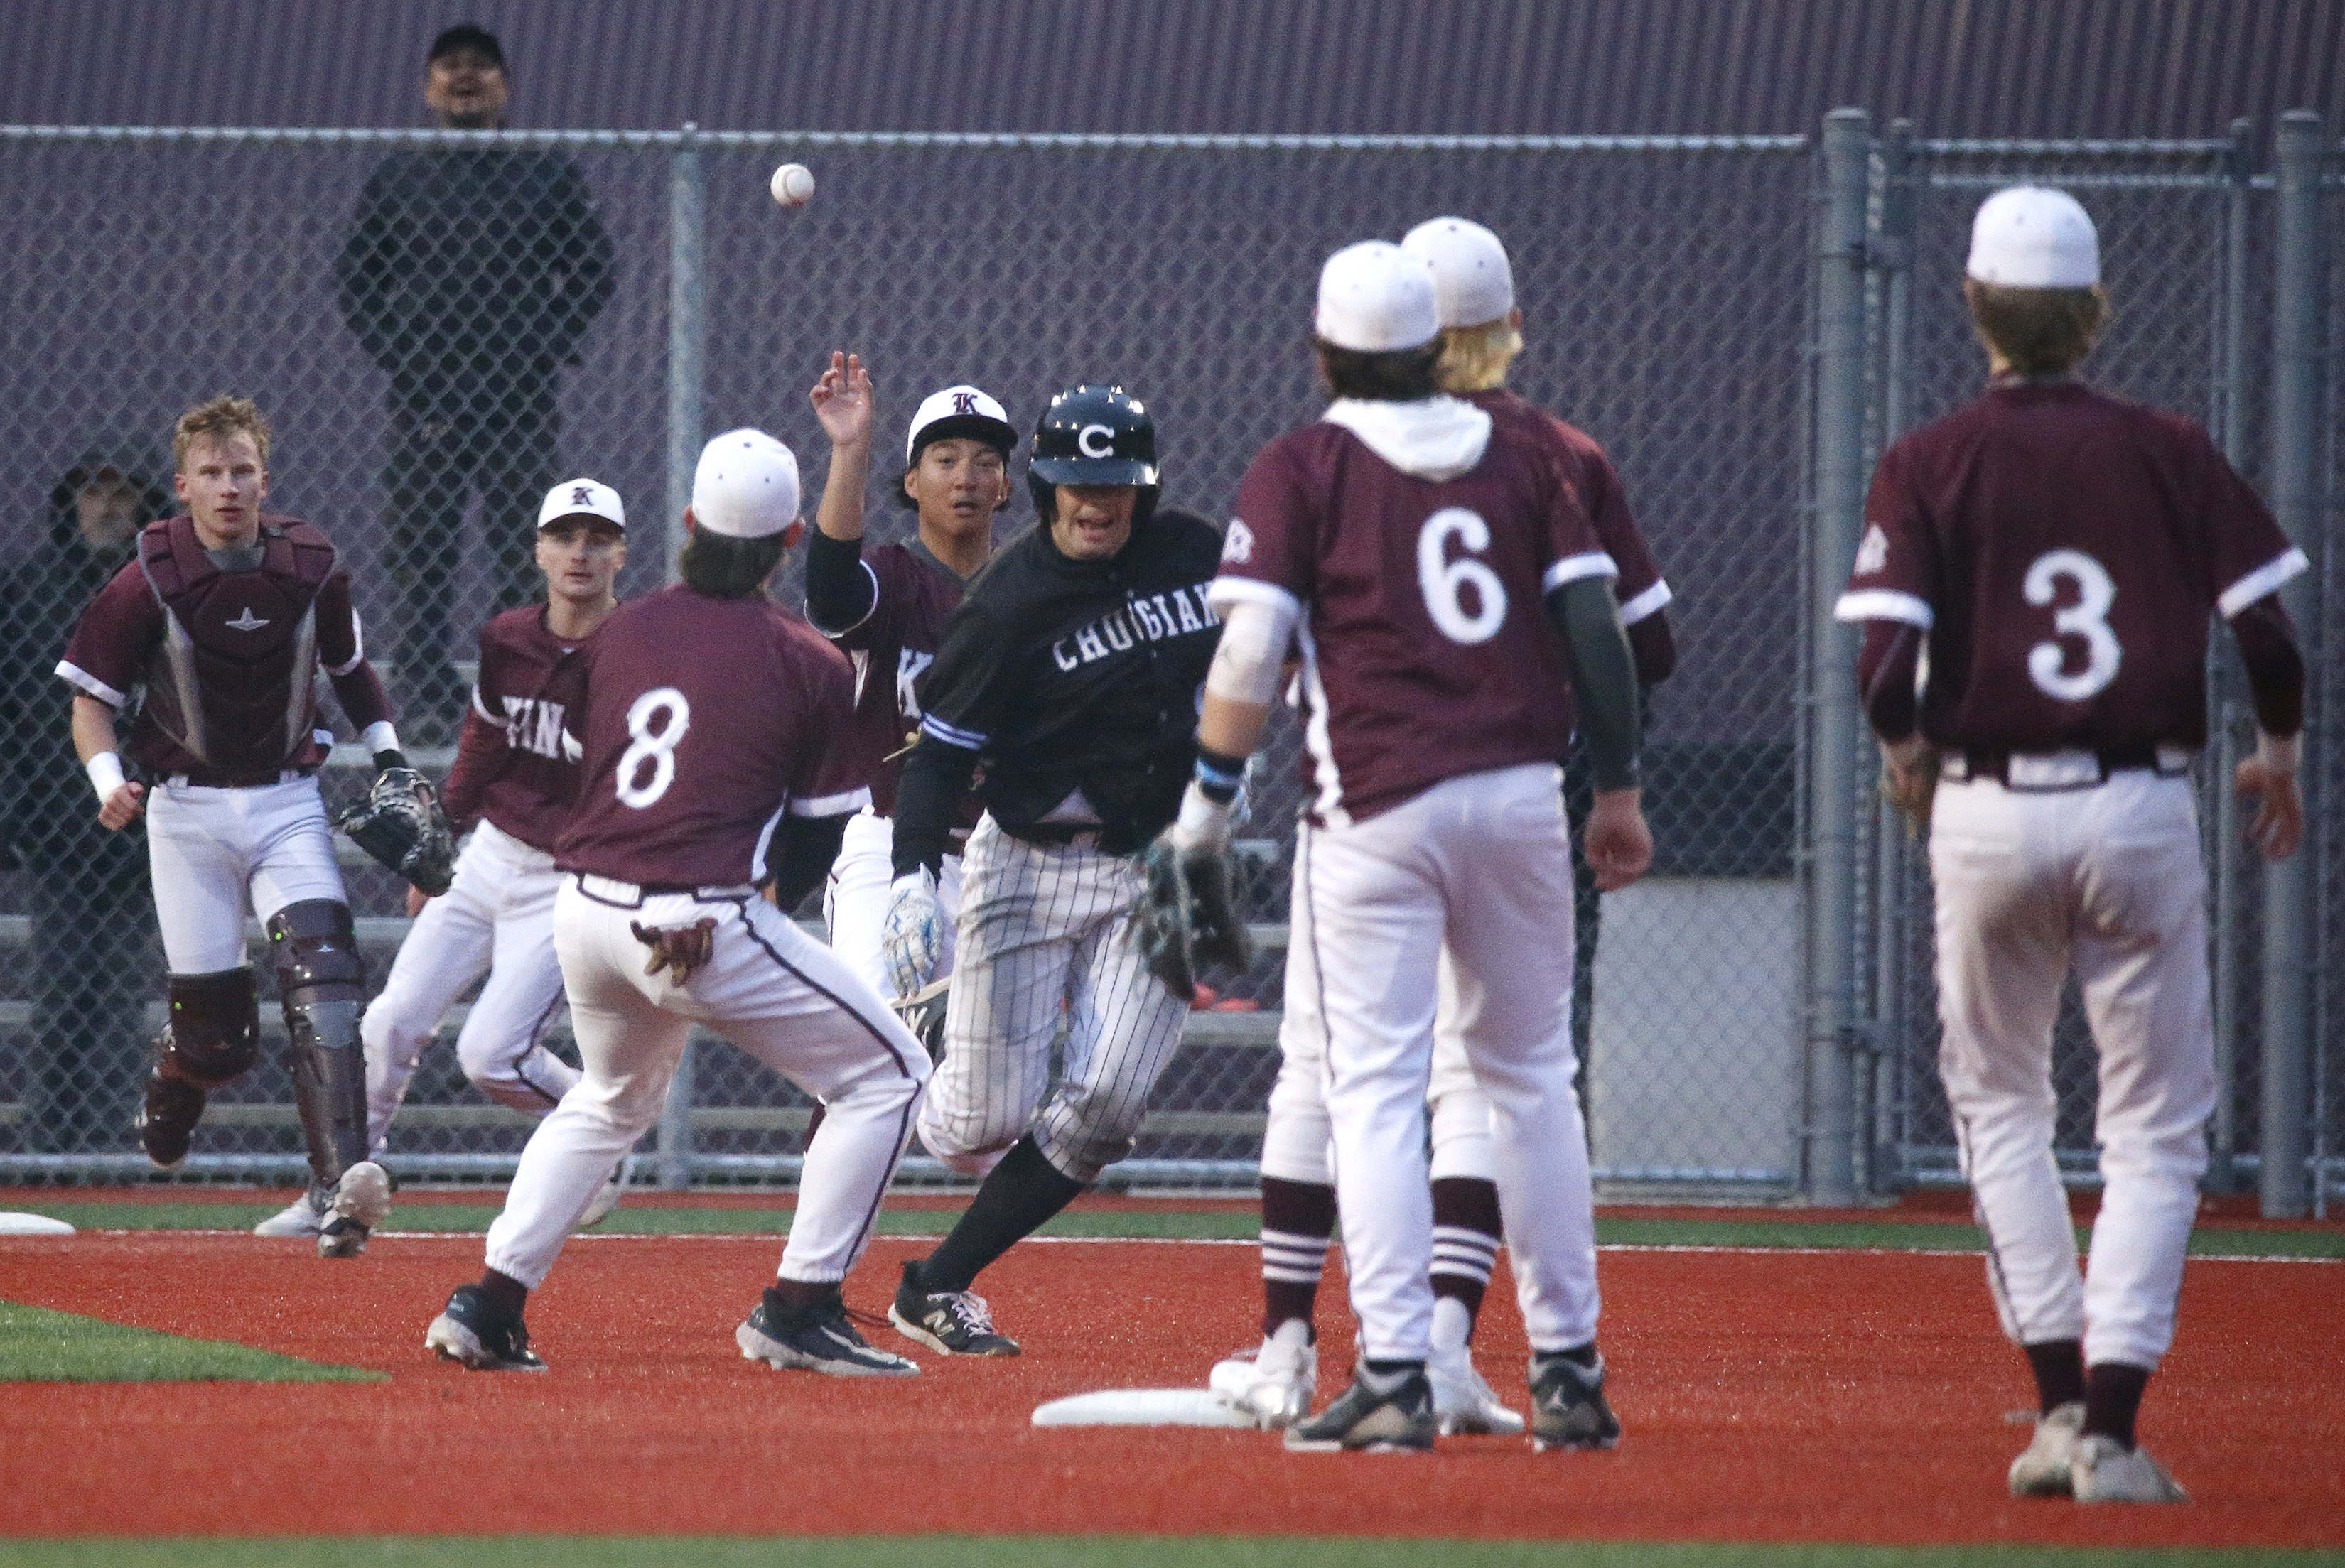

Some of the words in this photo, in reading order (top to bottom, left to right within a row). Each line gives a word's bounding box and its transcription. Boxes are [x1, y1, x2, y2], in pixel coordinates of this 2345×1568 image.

[1079, 424, 1114, 458] C
[1418, 507, 1508, 644] 6
[2023, 548, 2122, 700] 3
[616, 687, 689, 809] 8
